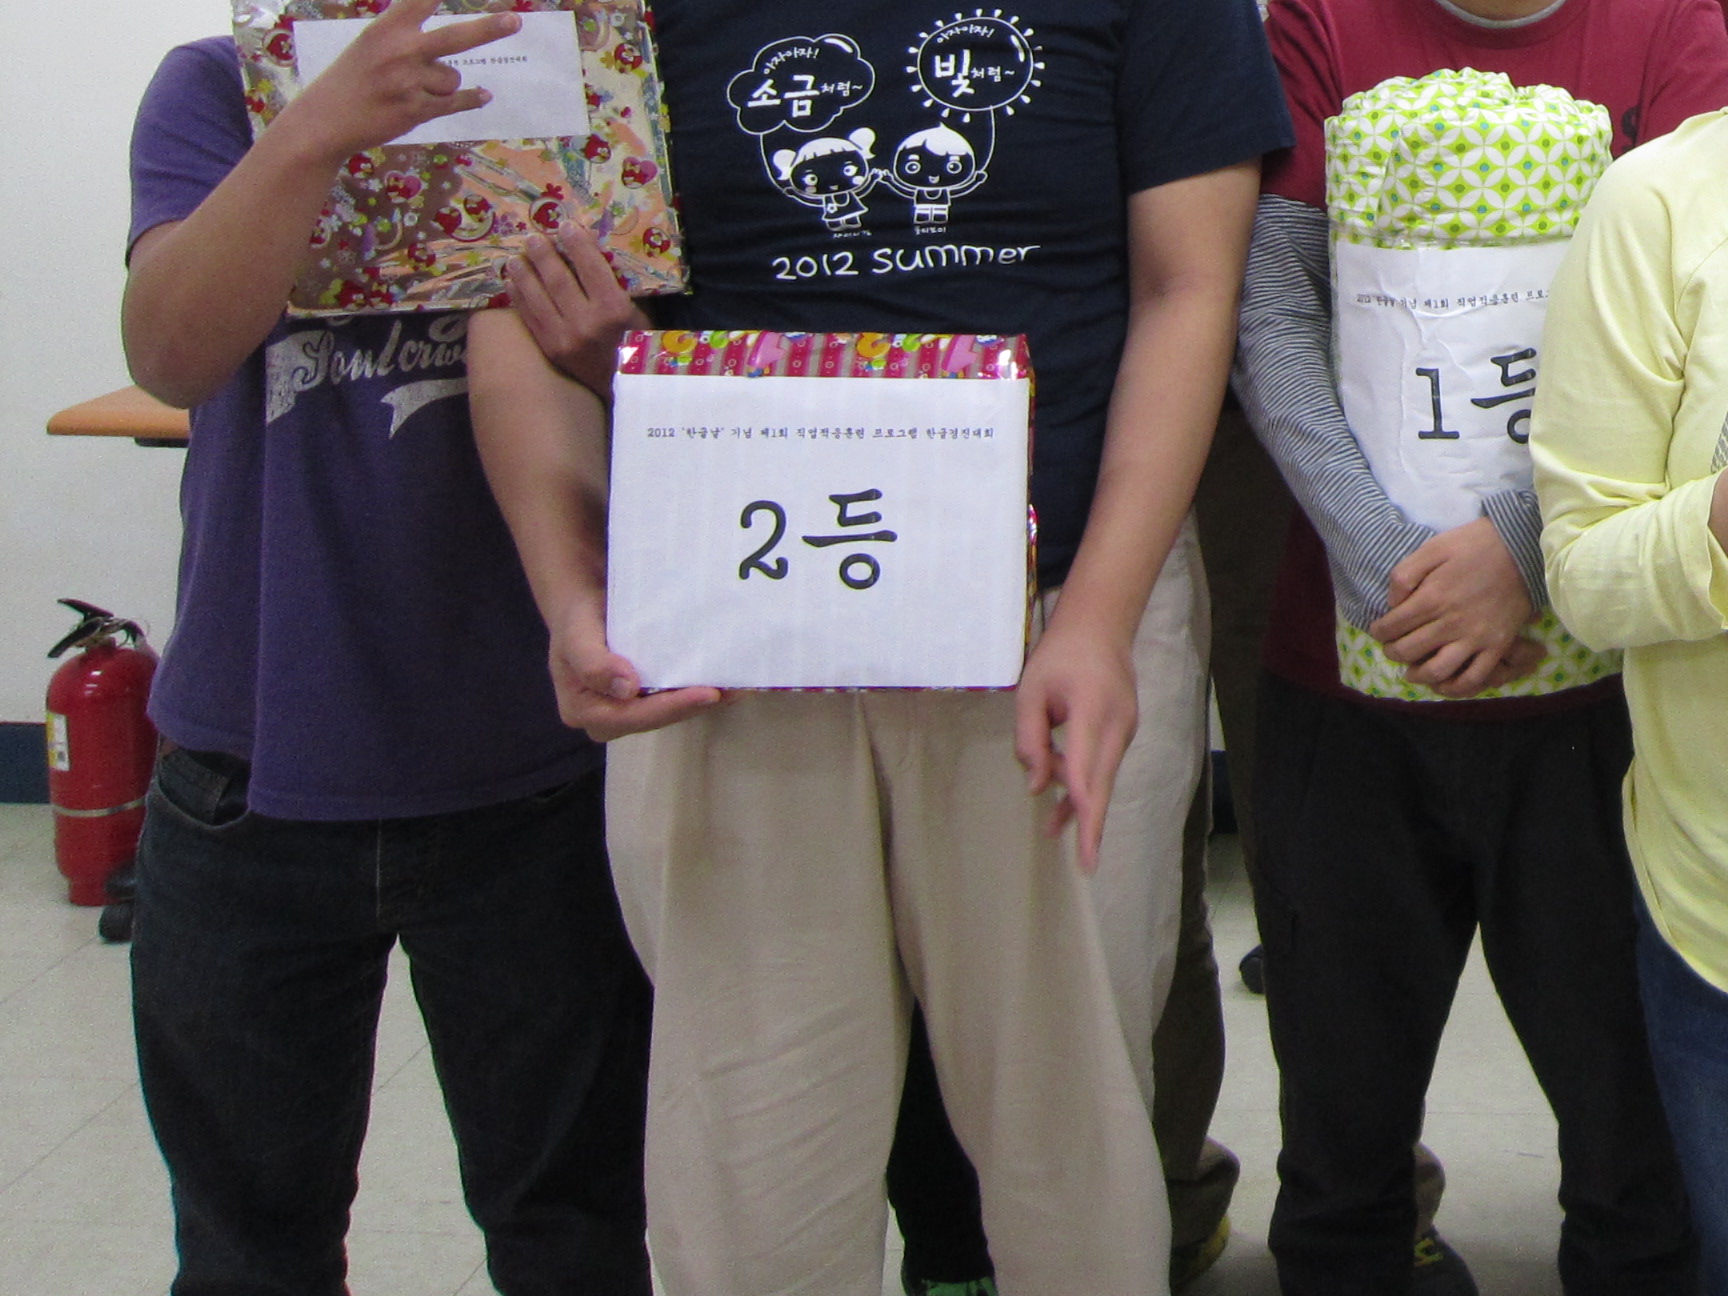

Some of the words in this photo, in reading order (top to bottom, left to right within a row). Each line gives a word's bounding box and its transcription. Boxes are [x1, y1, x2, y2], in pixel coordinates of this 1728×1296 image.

[937, 23, 995, 45] 아자아자!
[763, 46, 820, 75] 아자아자!
[772, 253, 859, 280] 2012
[1525, 289, 1550, 301] 프로
[1415, 347, 1537, 444] 1등
[647, 426, 676, 438] 2012
[731, 426, 753, 439] 기념
[760, 426, 789, 439] 제1회
[872, 427, 918, 439] 프로그램
[738, 488, 898, 590] 2등
